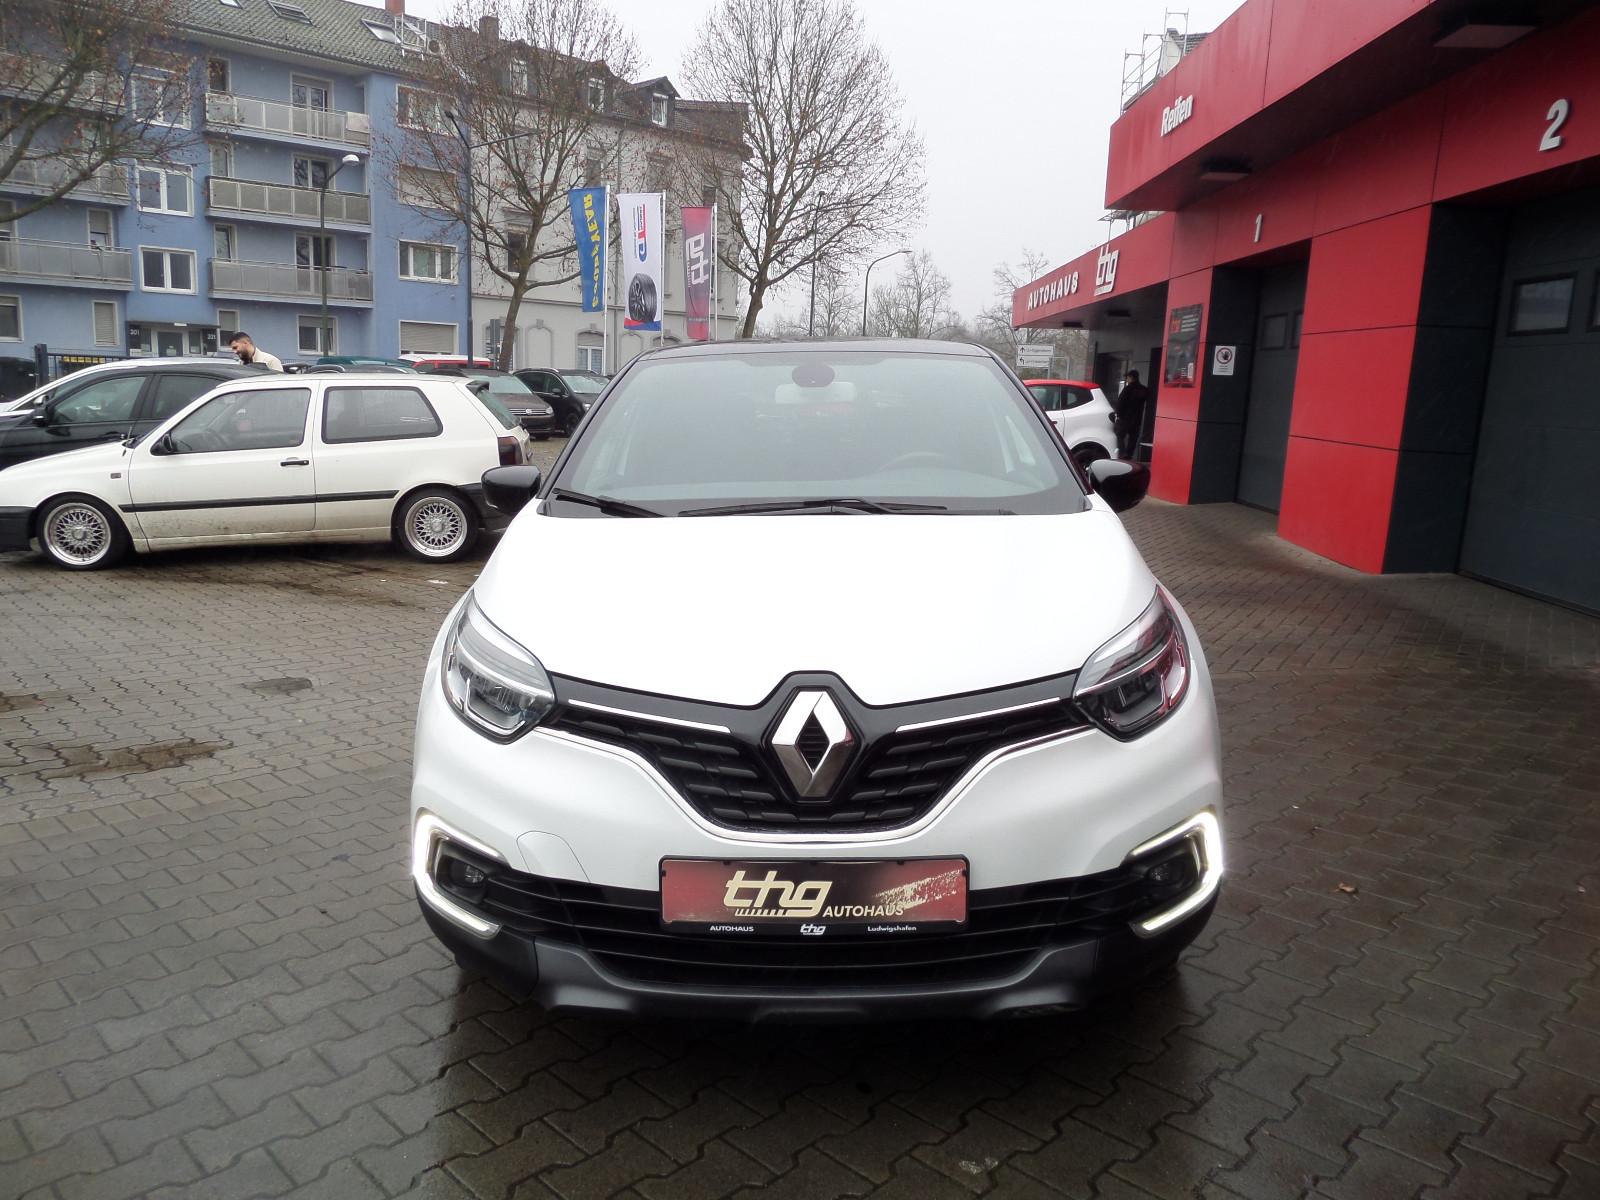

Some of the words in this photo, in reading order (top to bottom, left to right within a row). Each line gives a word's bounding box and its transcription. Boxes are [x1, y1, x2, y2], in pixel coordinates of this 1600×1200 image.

[1160, 94, 1194, 137] Reifen
[1539, 98, 1569, 152] 2
[1254, 213, 1264, 243] 1
[1028, 271, 1079, 311] AUTOHAUS
[1094, 244, 1120, 297] thg
[723, 870, 833, 918] thg
[822, 905, 904, 918] AUTOHAUS
[800, 924, 827, 936] thg
[867, 925, 917, 933] Ludwigshafen
